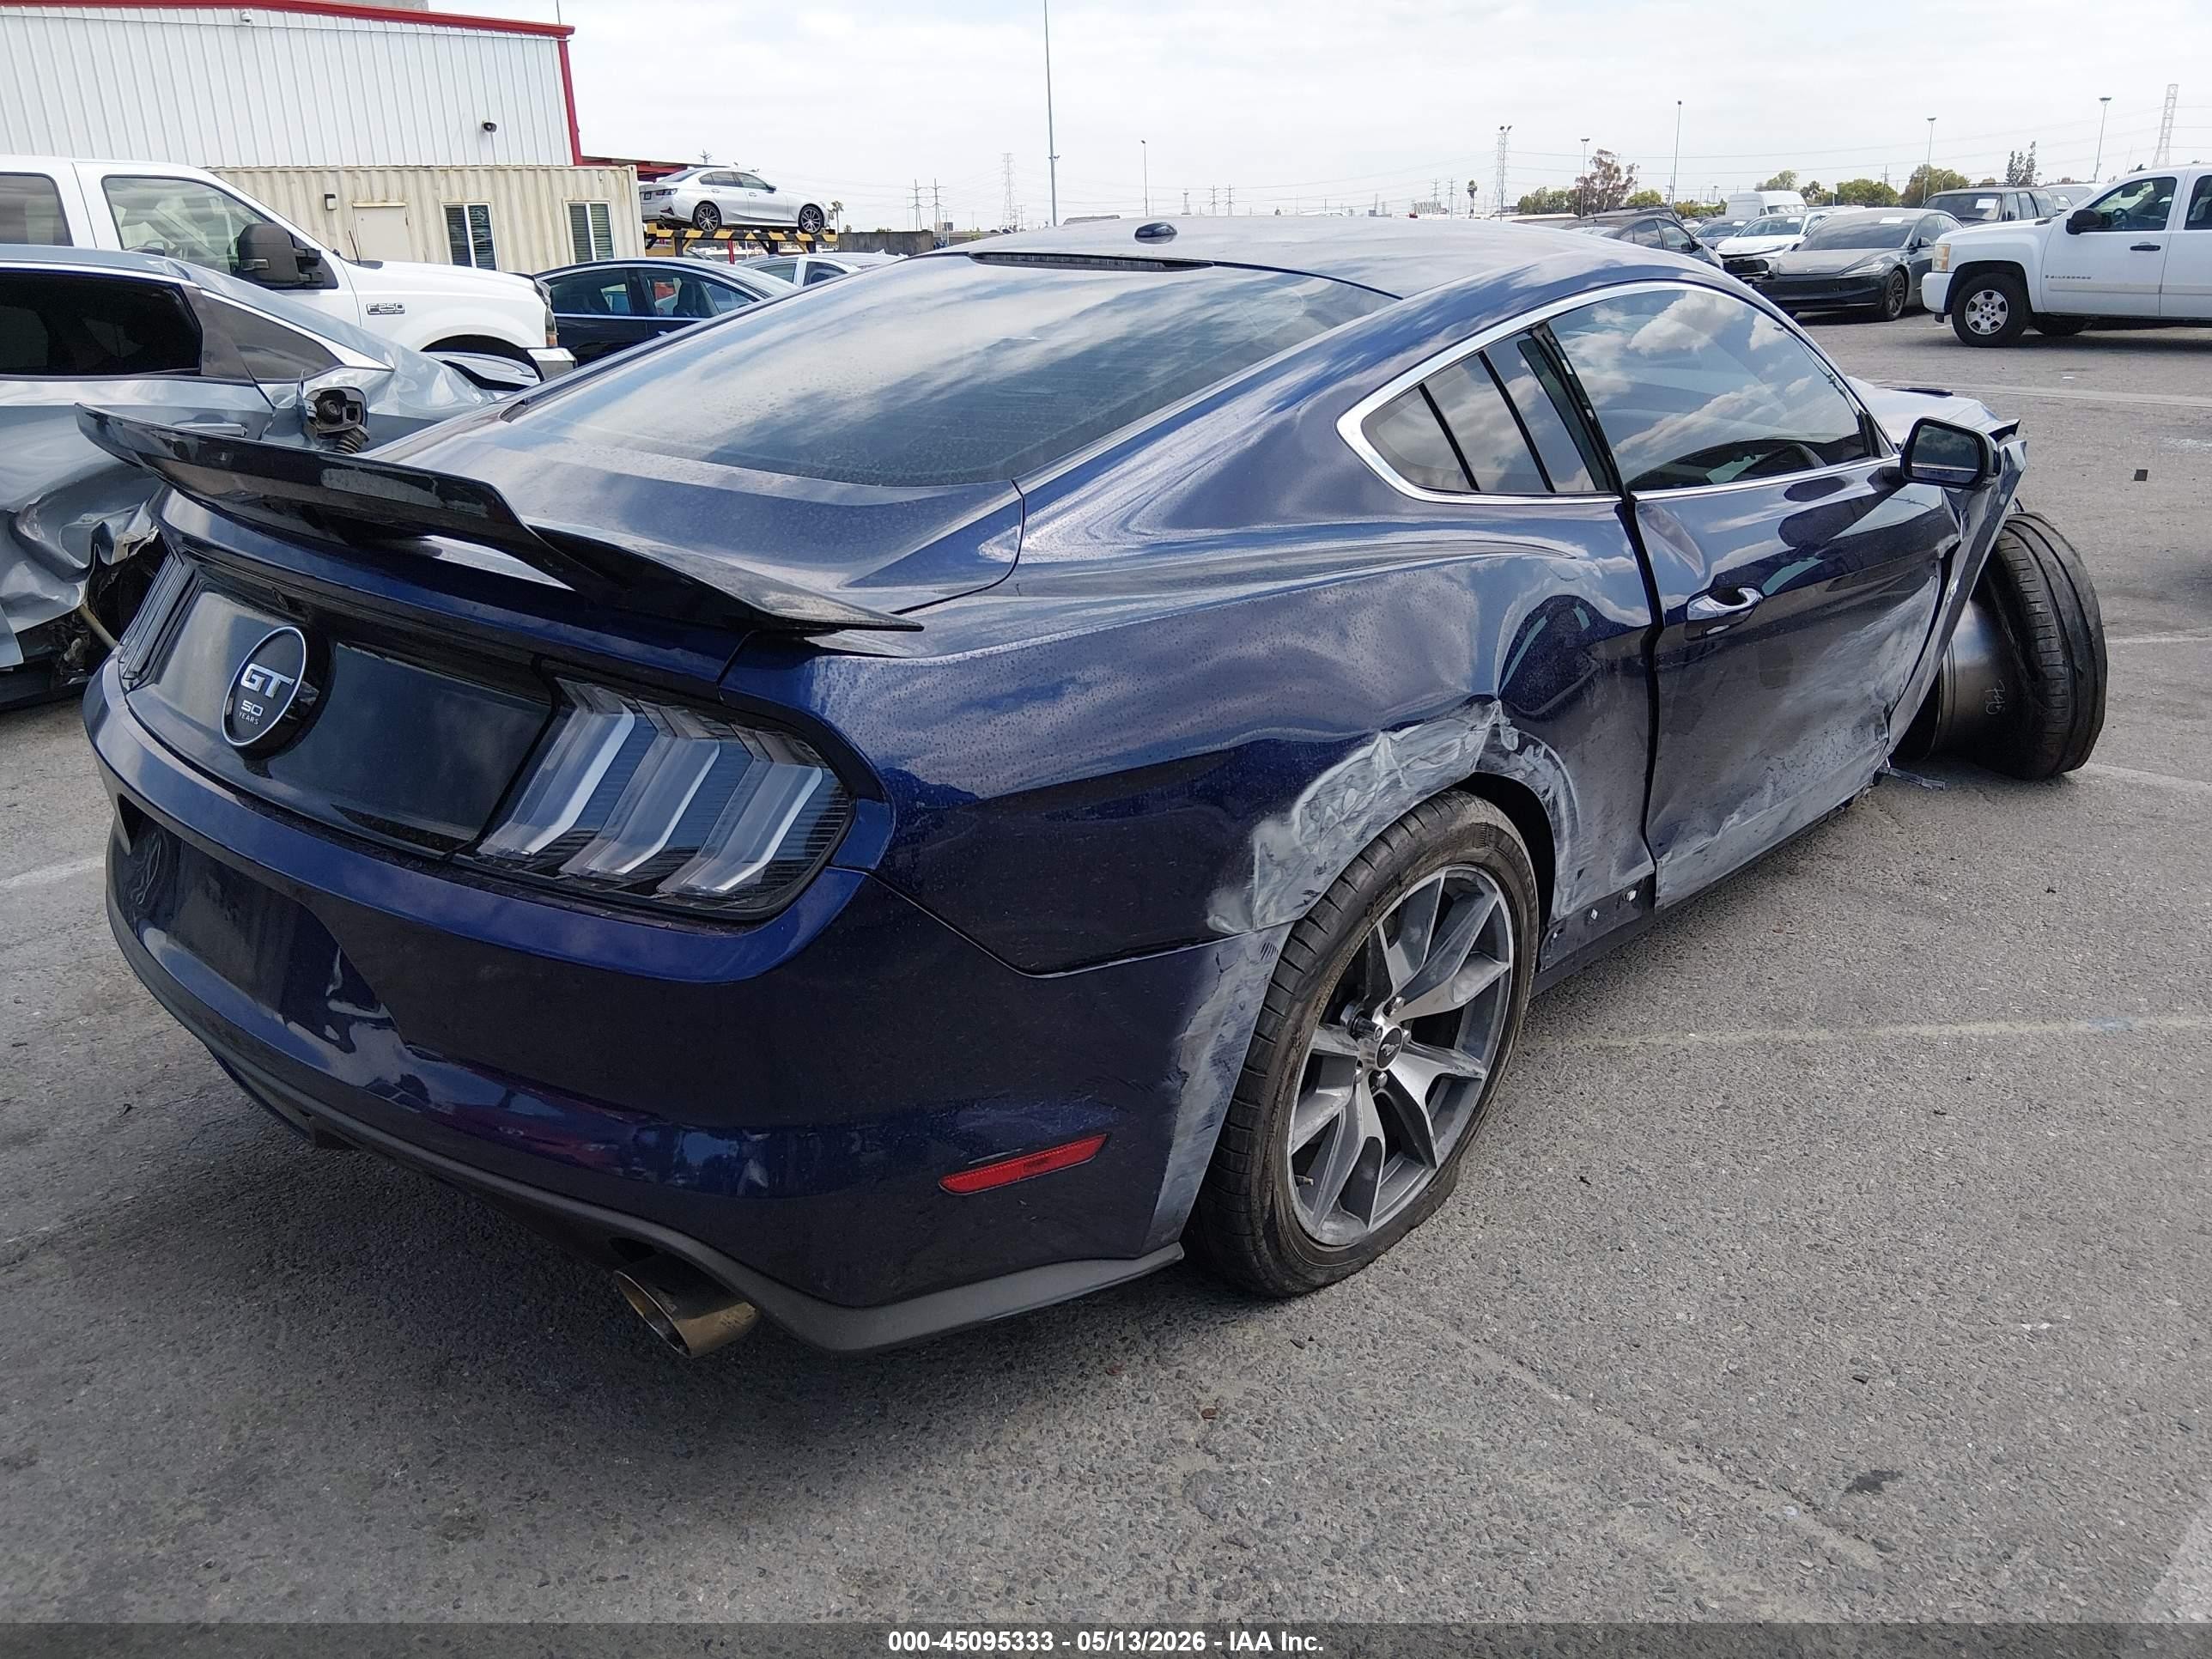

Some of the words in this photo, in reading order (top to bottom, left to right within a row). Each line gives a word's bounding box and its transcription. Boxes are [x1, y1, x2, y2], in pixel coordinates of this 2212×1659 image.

[240, 663, 295, 699] GT
[241, 700, 264, 716] 50
[240, 711, 259, 725] YEARS
